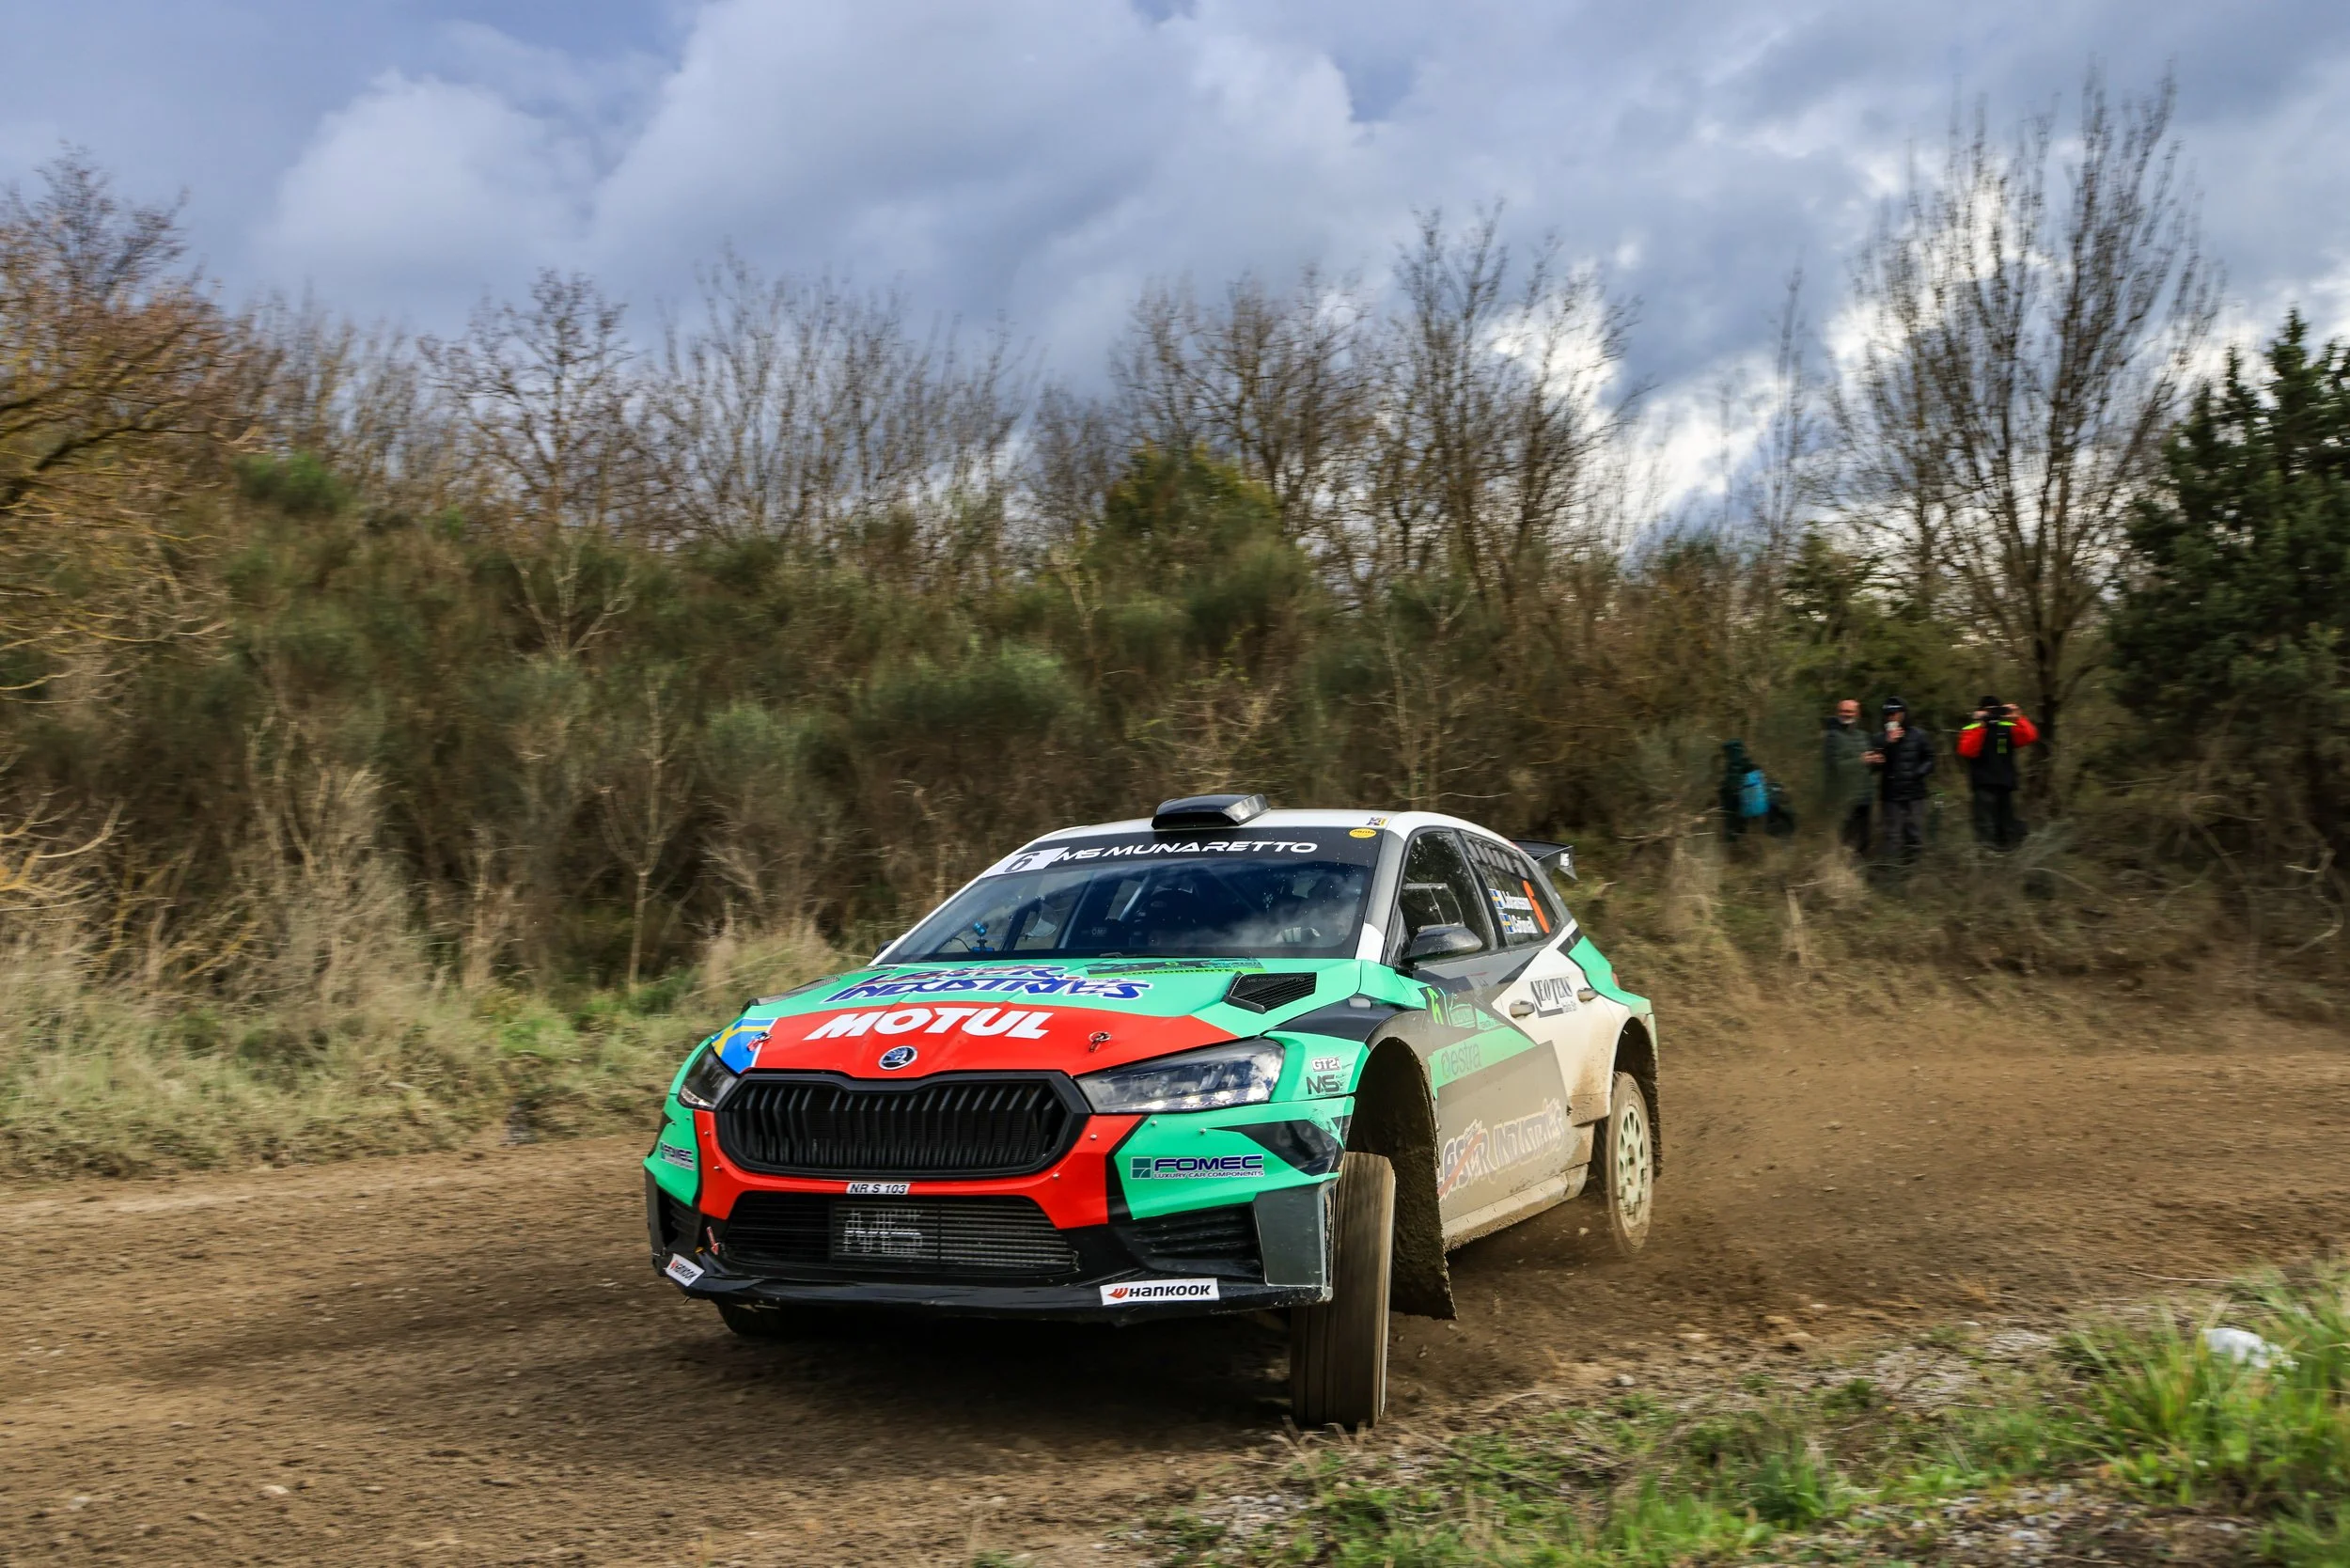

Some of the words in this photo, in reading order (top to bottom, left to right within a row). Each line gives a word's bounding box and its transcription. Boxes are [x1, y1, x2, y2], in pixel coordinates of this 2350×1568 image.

[1052, 847, 1109, 862] MS
[1102, 841, 1318, 857] MUNARETTO
[1004, 852, 1041, 872] 6
[804, 1008, 1054, 1040] MOTUL
[1307, 1074, 1340, 1094] MS
[1154, 1154, 1263, 1171] FOMEC
[850, 1184, 869, 1194] NR
[871, 1184, 881, 1194] S
[885, 1184, 907, 1194] 103
